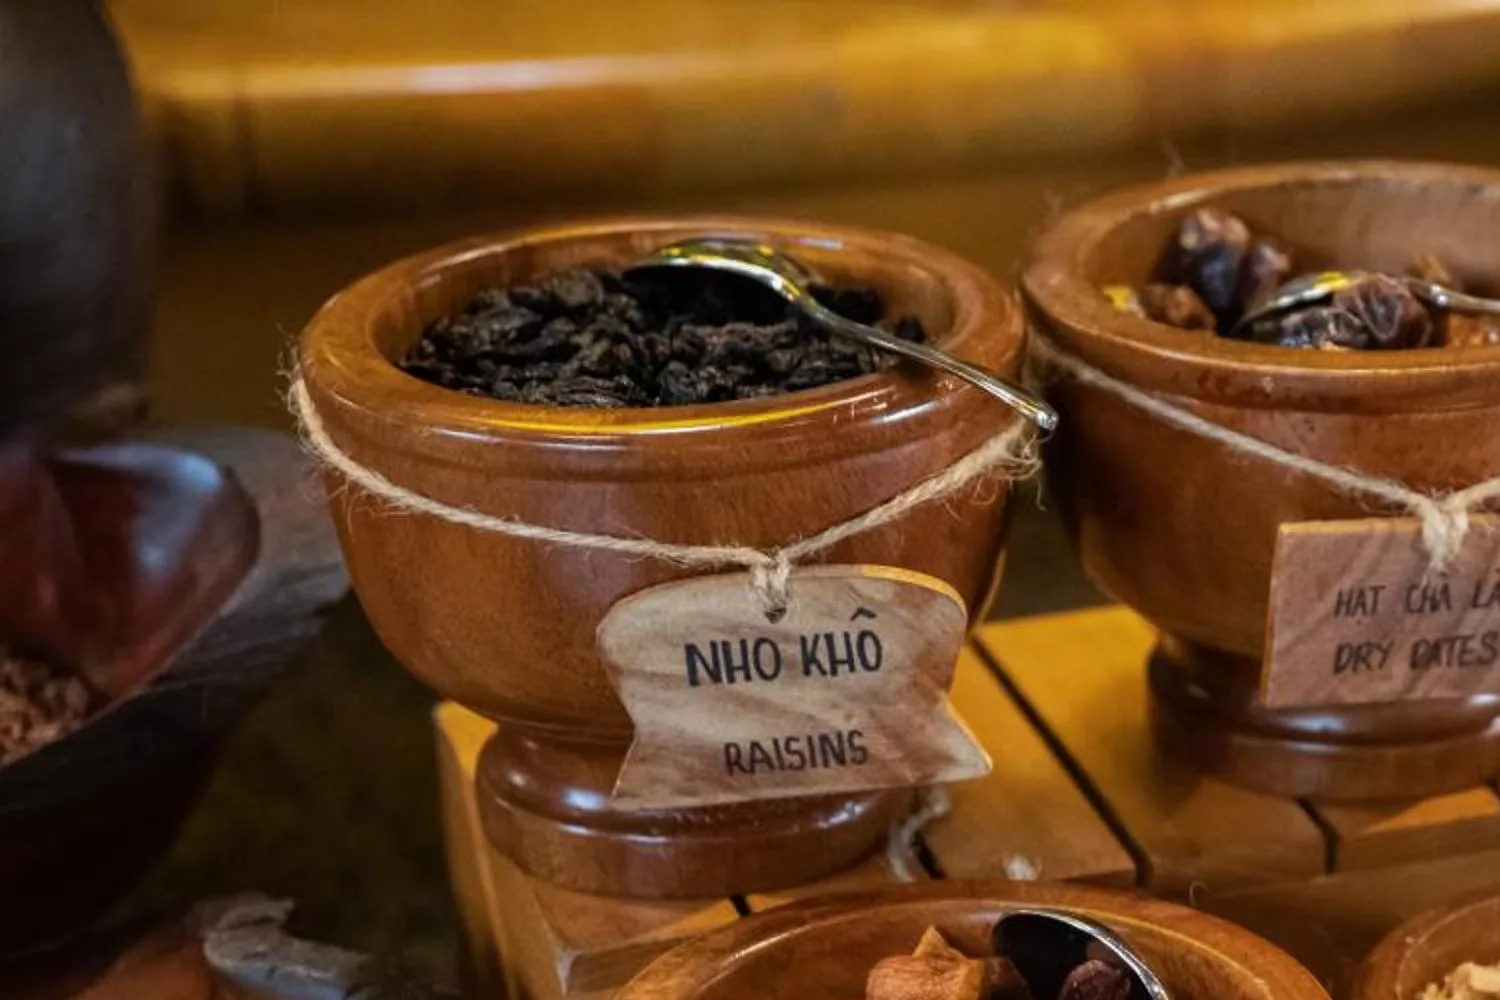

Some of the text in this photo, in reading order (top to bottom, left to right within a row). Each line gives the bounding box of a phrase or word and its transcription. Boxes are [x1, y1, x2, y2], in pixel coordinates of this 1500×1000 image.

[684, 606, 884, 687] NHO KHÔ
[1333, 630, 1500, 676] DRY DATES
[724, 729, 869, 777] RAISINS
